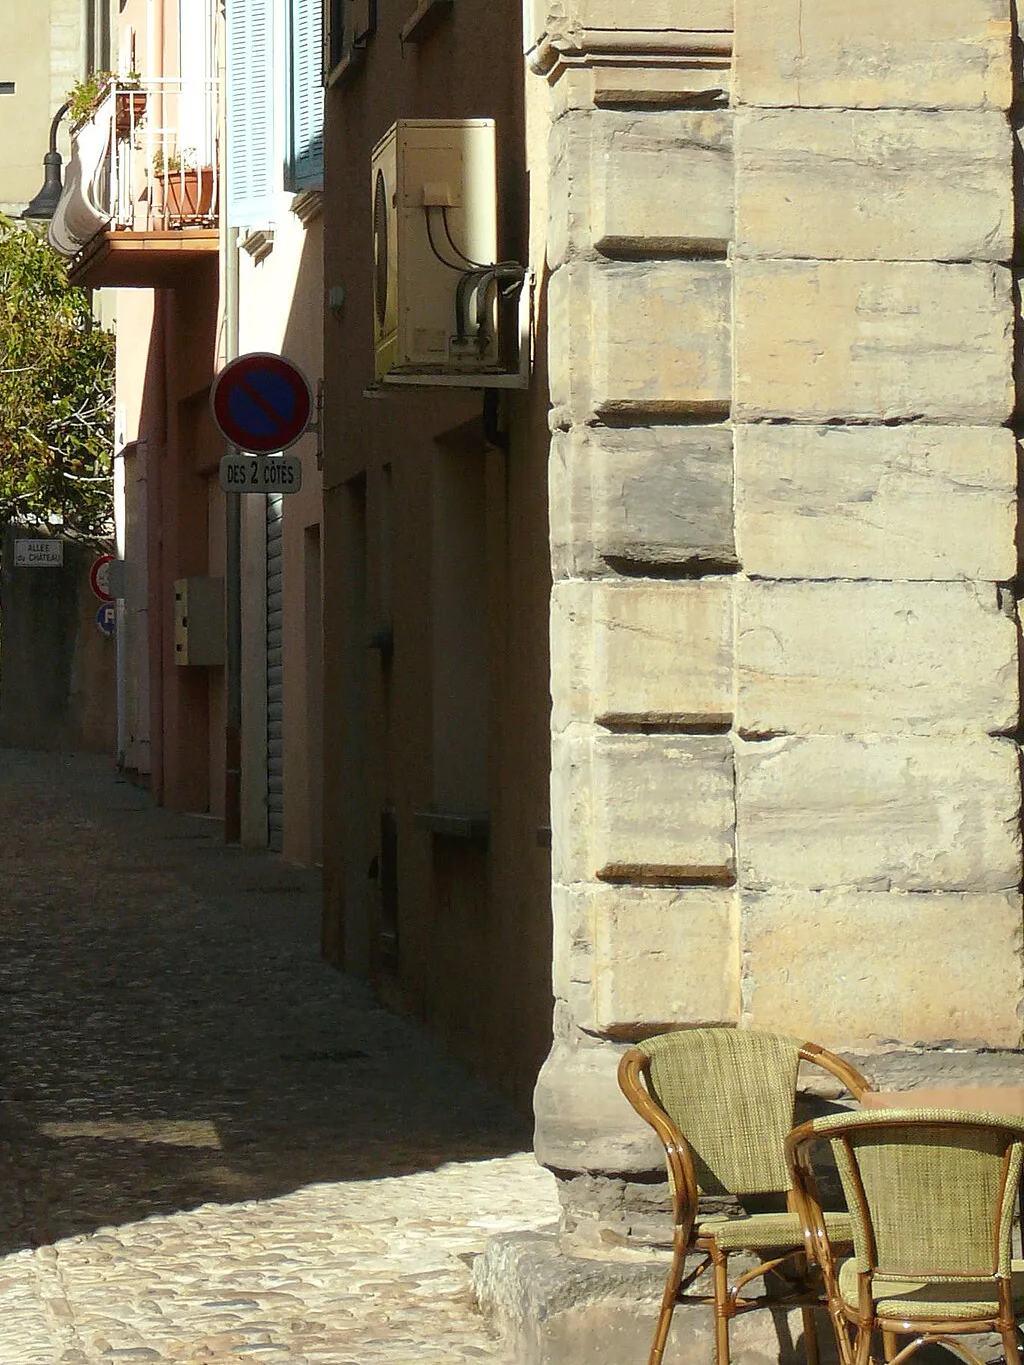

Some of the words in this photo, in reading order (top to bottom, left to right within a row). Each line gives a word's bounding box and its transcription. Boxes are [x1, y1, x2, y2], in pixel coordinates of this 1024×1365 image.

[227, 465, 247, 484] DES
[250, 461, 259, 484] 2
[264, 460, 295, 484] CÔTÉS
